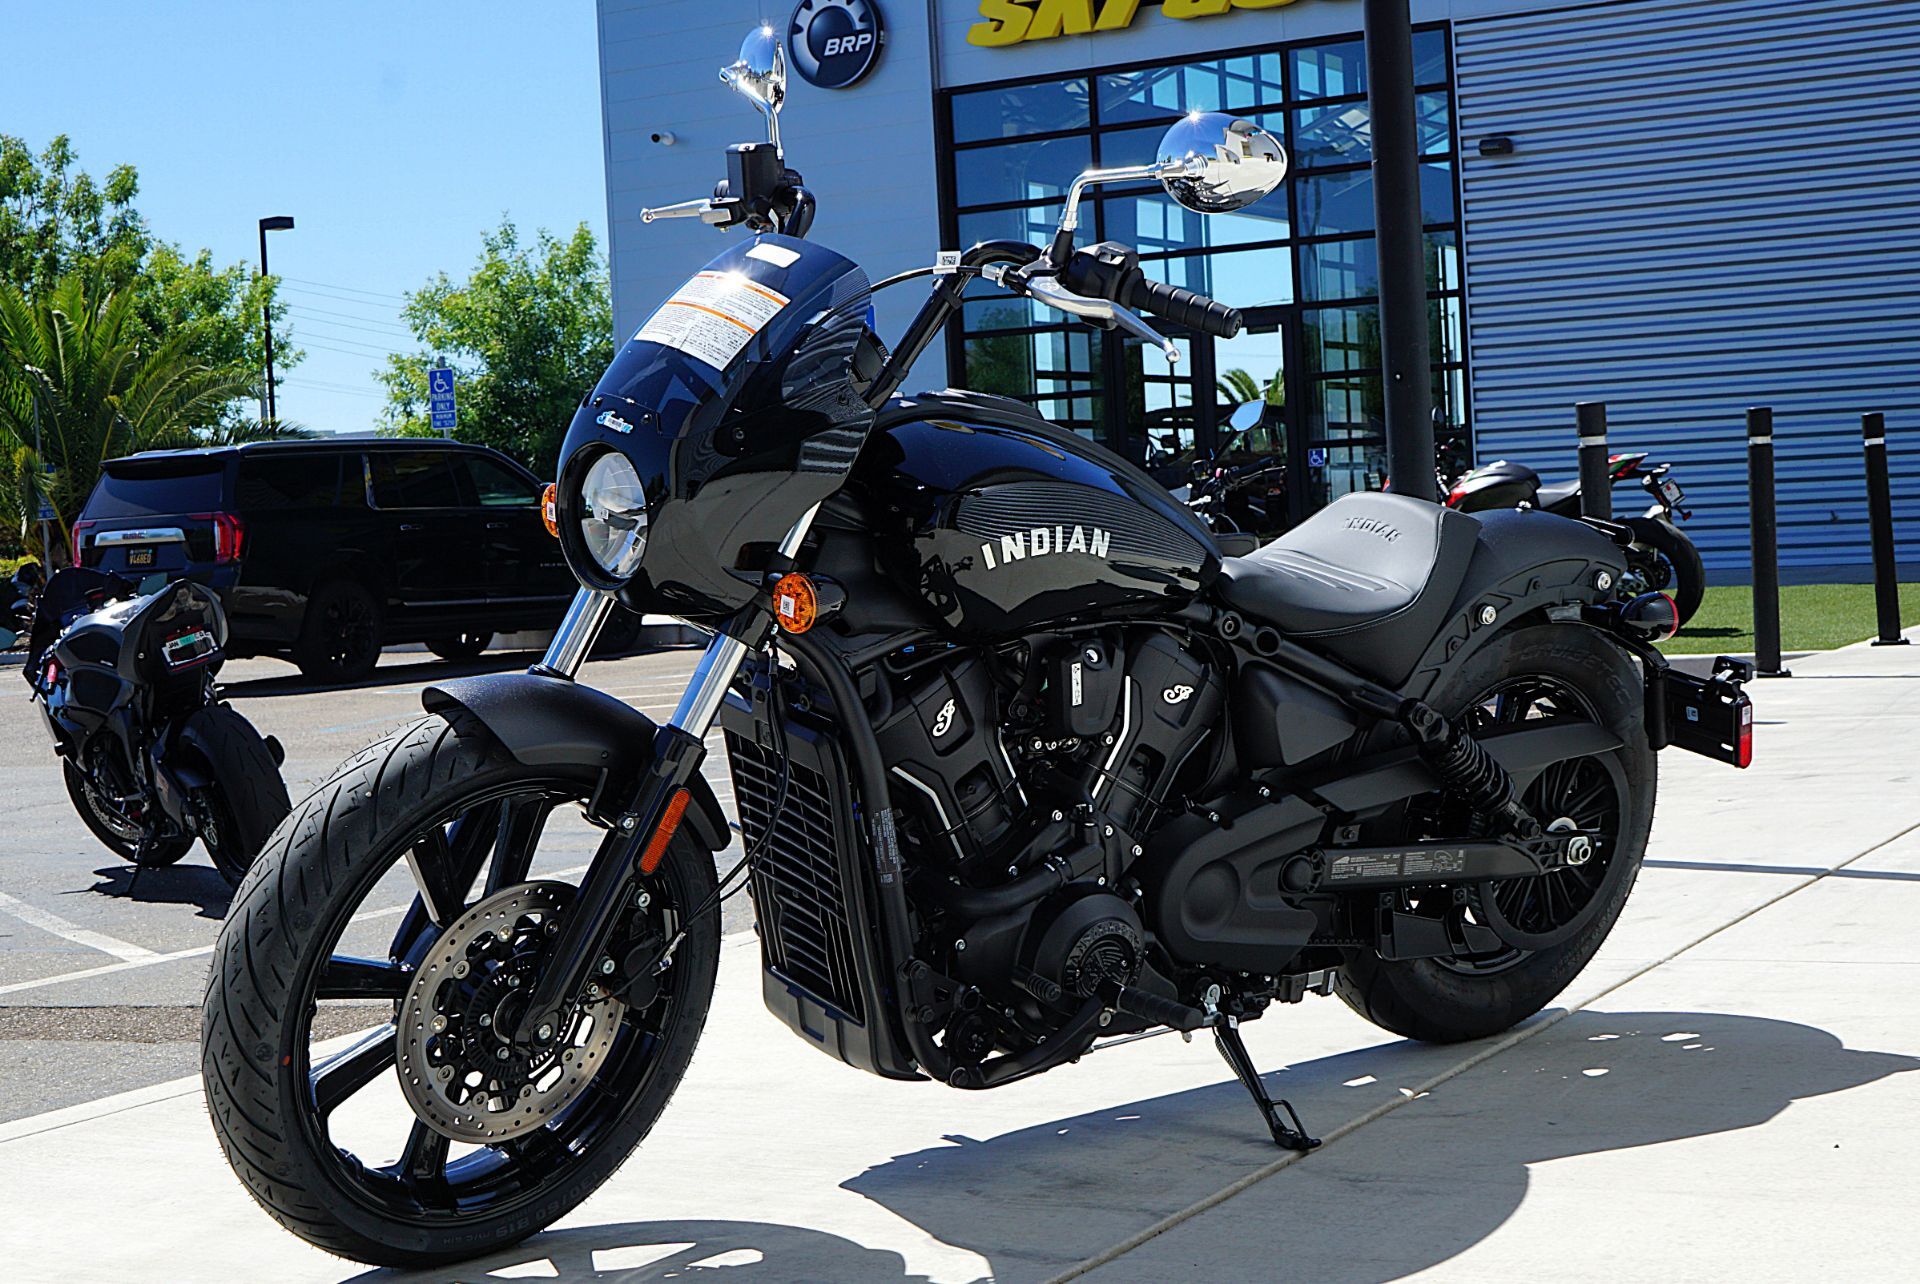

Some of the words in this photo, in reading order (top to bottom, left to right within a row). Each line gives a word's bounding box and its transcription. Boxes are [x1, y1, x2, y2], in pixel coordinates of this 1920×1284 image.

[824, 33, 872, 56] BRP
[1342, 517, 1402, 544] INDIAN
[981, 525, 1111, 570] INDIAN
